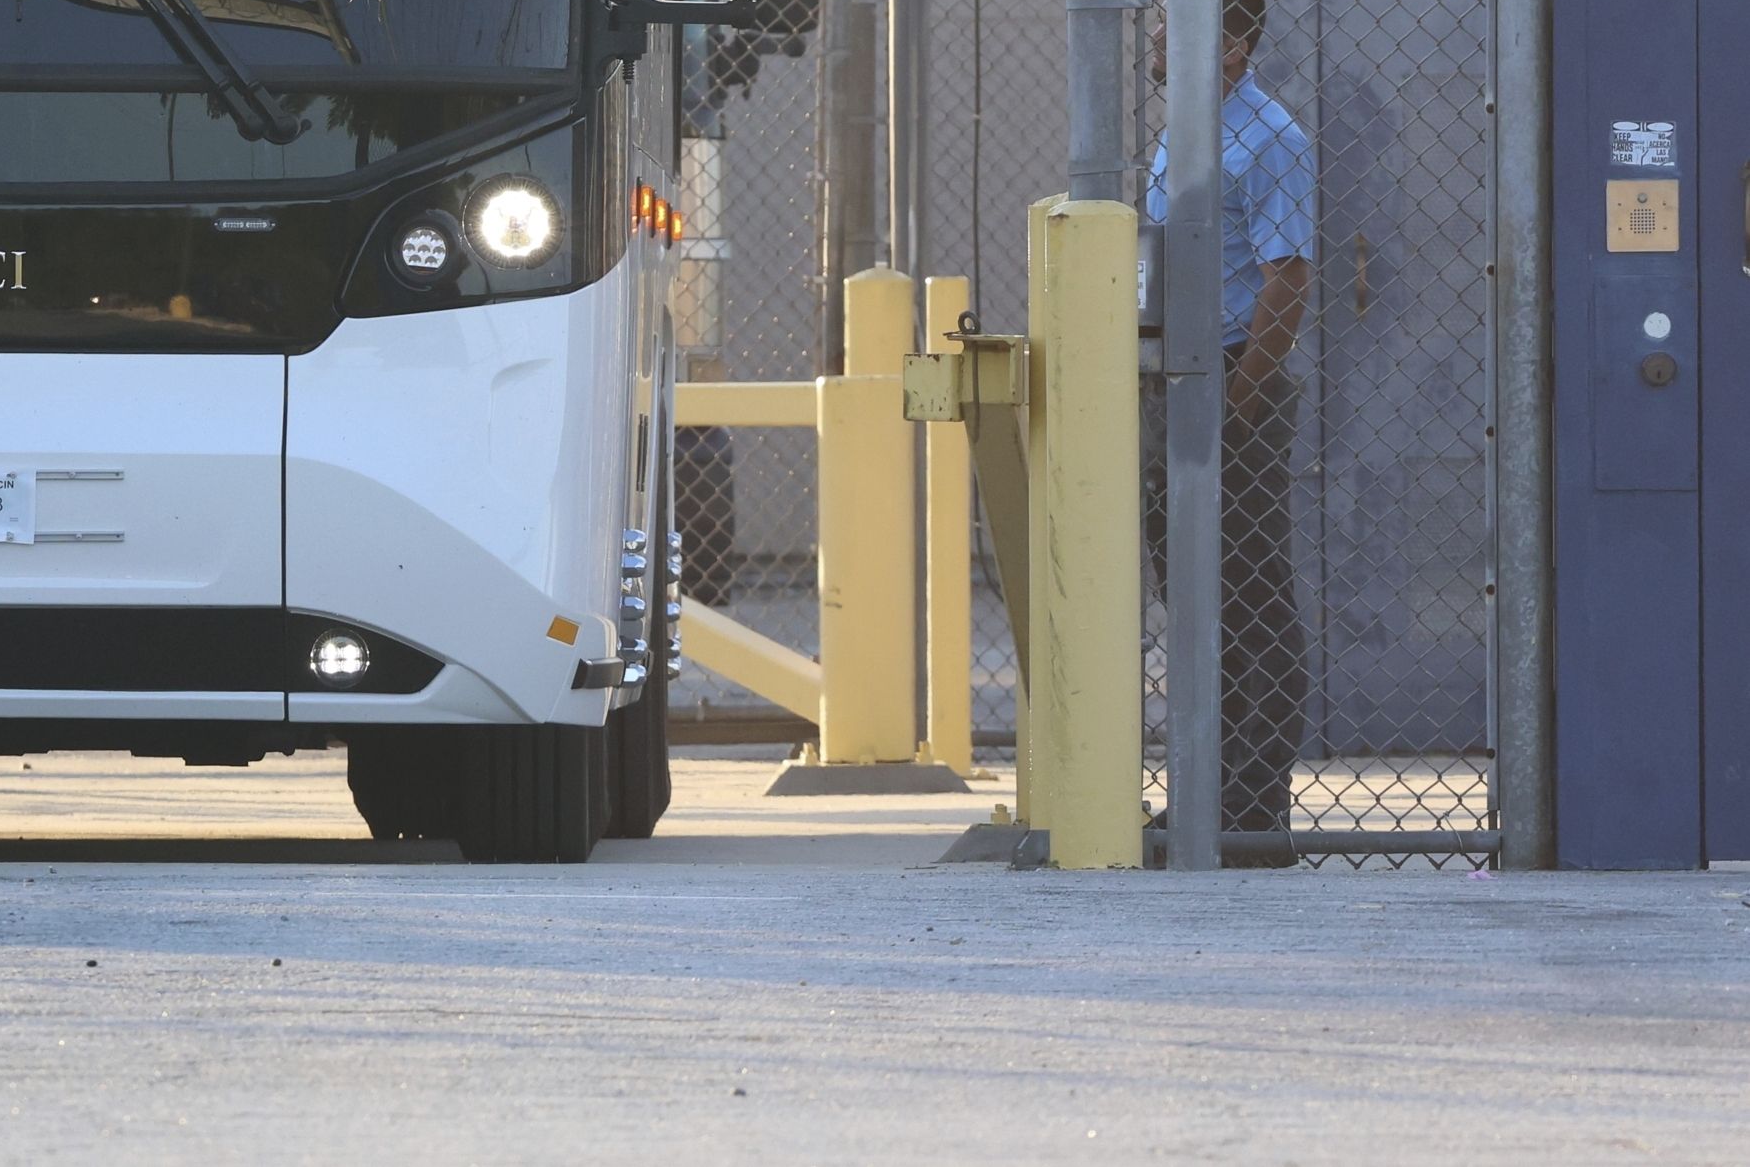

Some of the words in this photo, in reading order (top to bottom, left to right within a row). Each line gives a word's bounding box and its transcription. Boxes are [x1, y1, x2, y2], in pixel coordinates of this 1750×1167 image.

[1614, 133, 1631, 141] KEEP
[1612, 143, 1633, 152] HANDS
[1656, 148, 1667, 156] LAS
[1612, 154, 1633, 162] CLEAR
